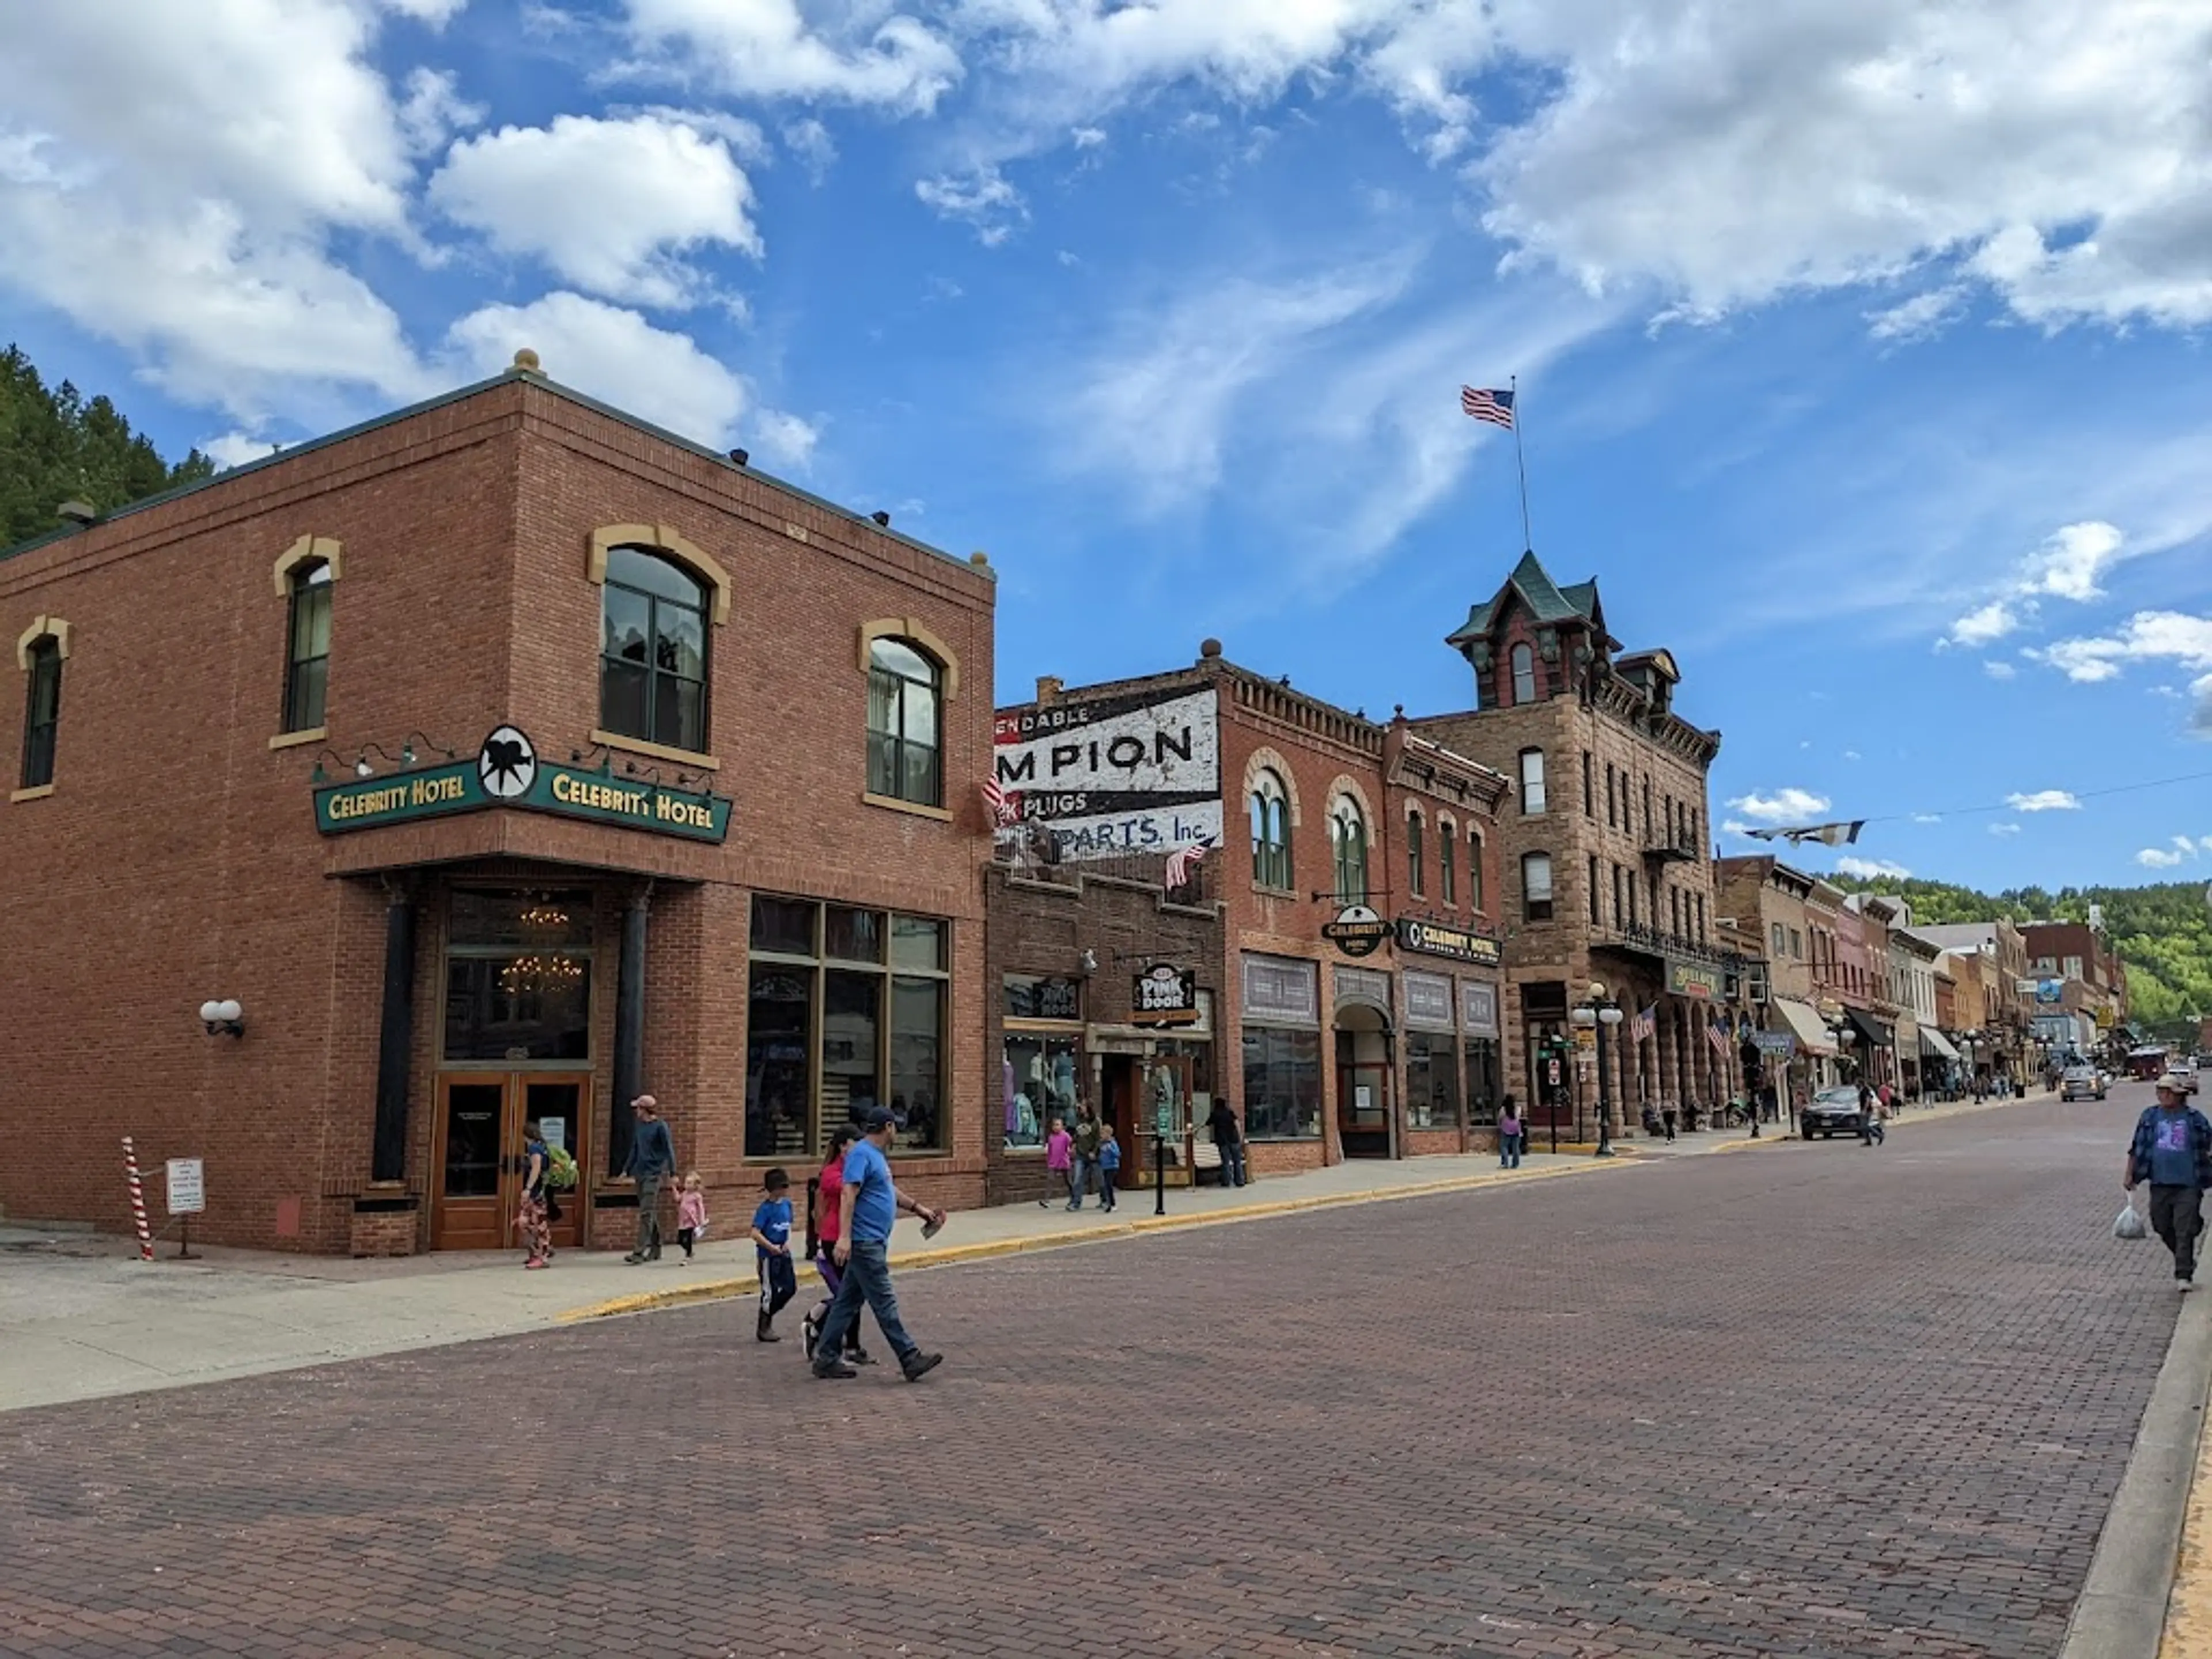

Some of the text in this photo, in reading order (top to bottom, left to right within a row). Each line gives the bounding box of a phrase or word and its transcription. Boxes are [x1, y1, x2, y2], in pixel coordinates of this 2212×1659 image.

[328, 776, 465, 820] CELEBRITY HOTEL
[553, 772, 714, 829] CELEBRITY HOTEL
[1023, 792, 1088, 818] PLUGS
[1140, 976, 1185, 997] PINK
[1142, 995, 1185, 1009] DOOR
